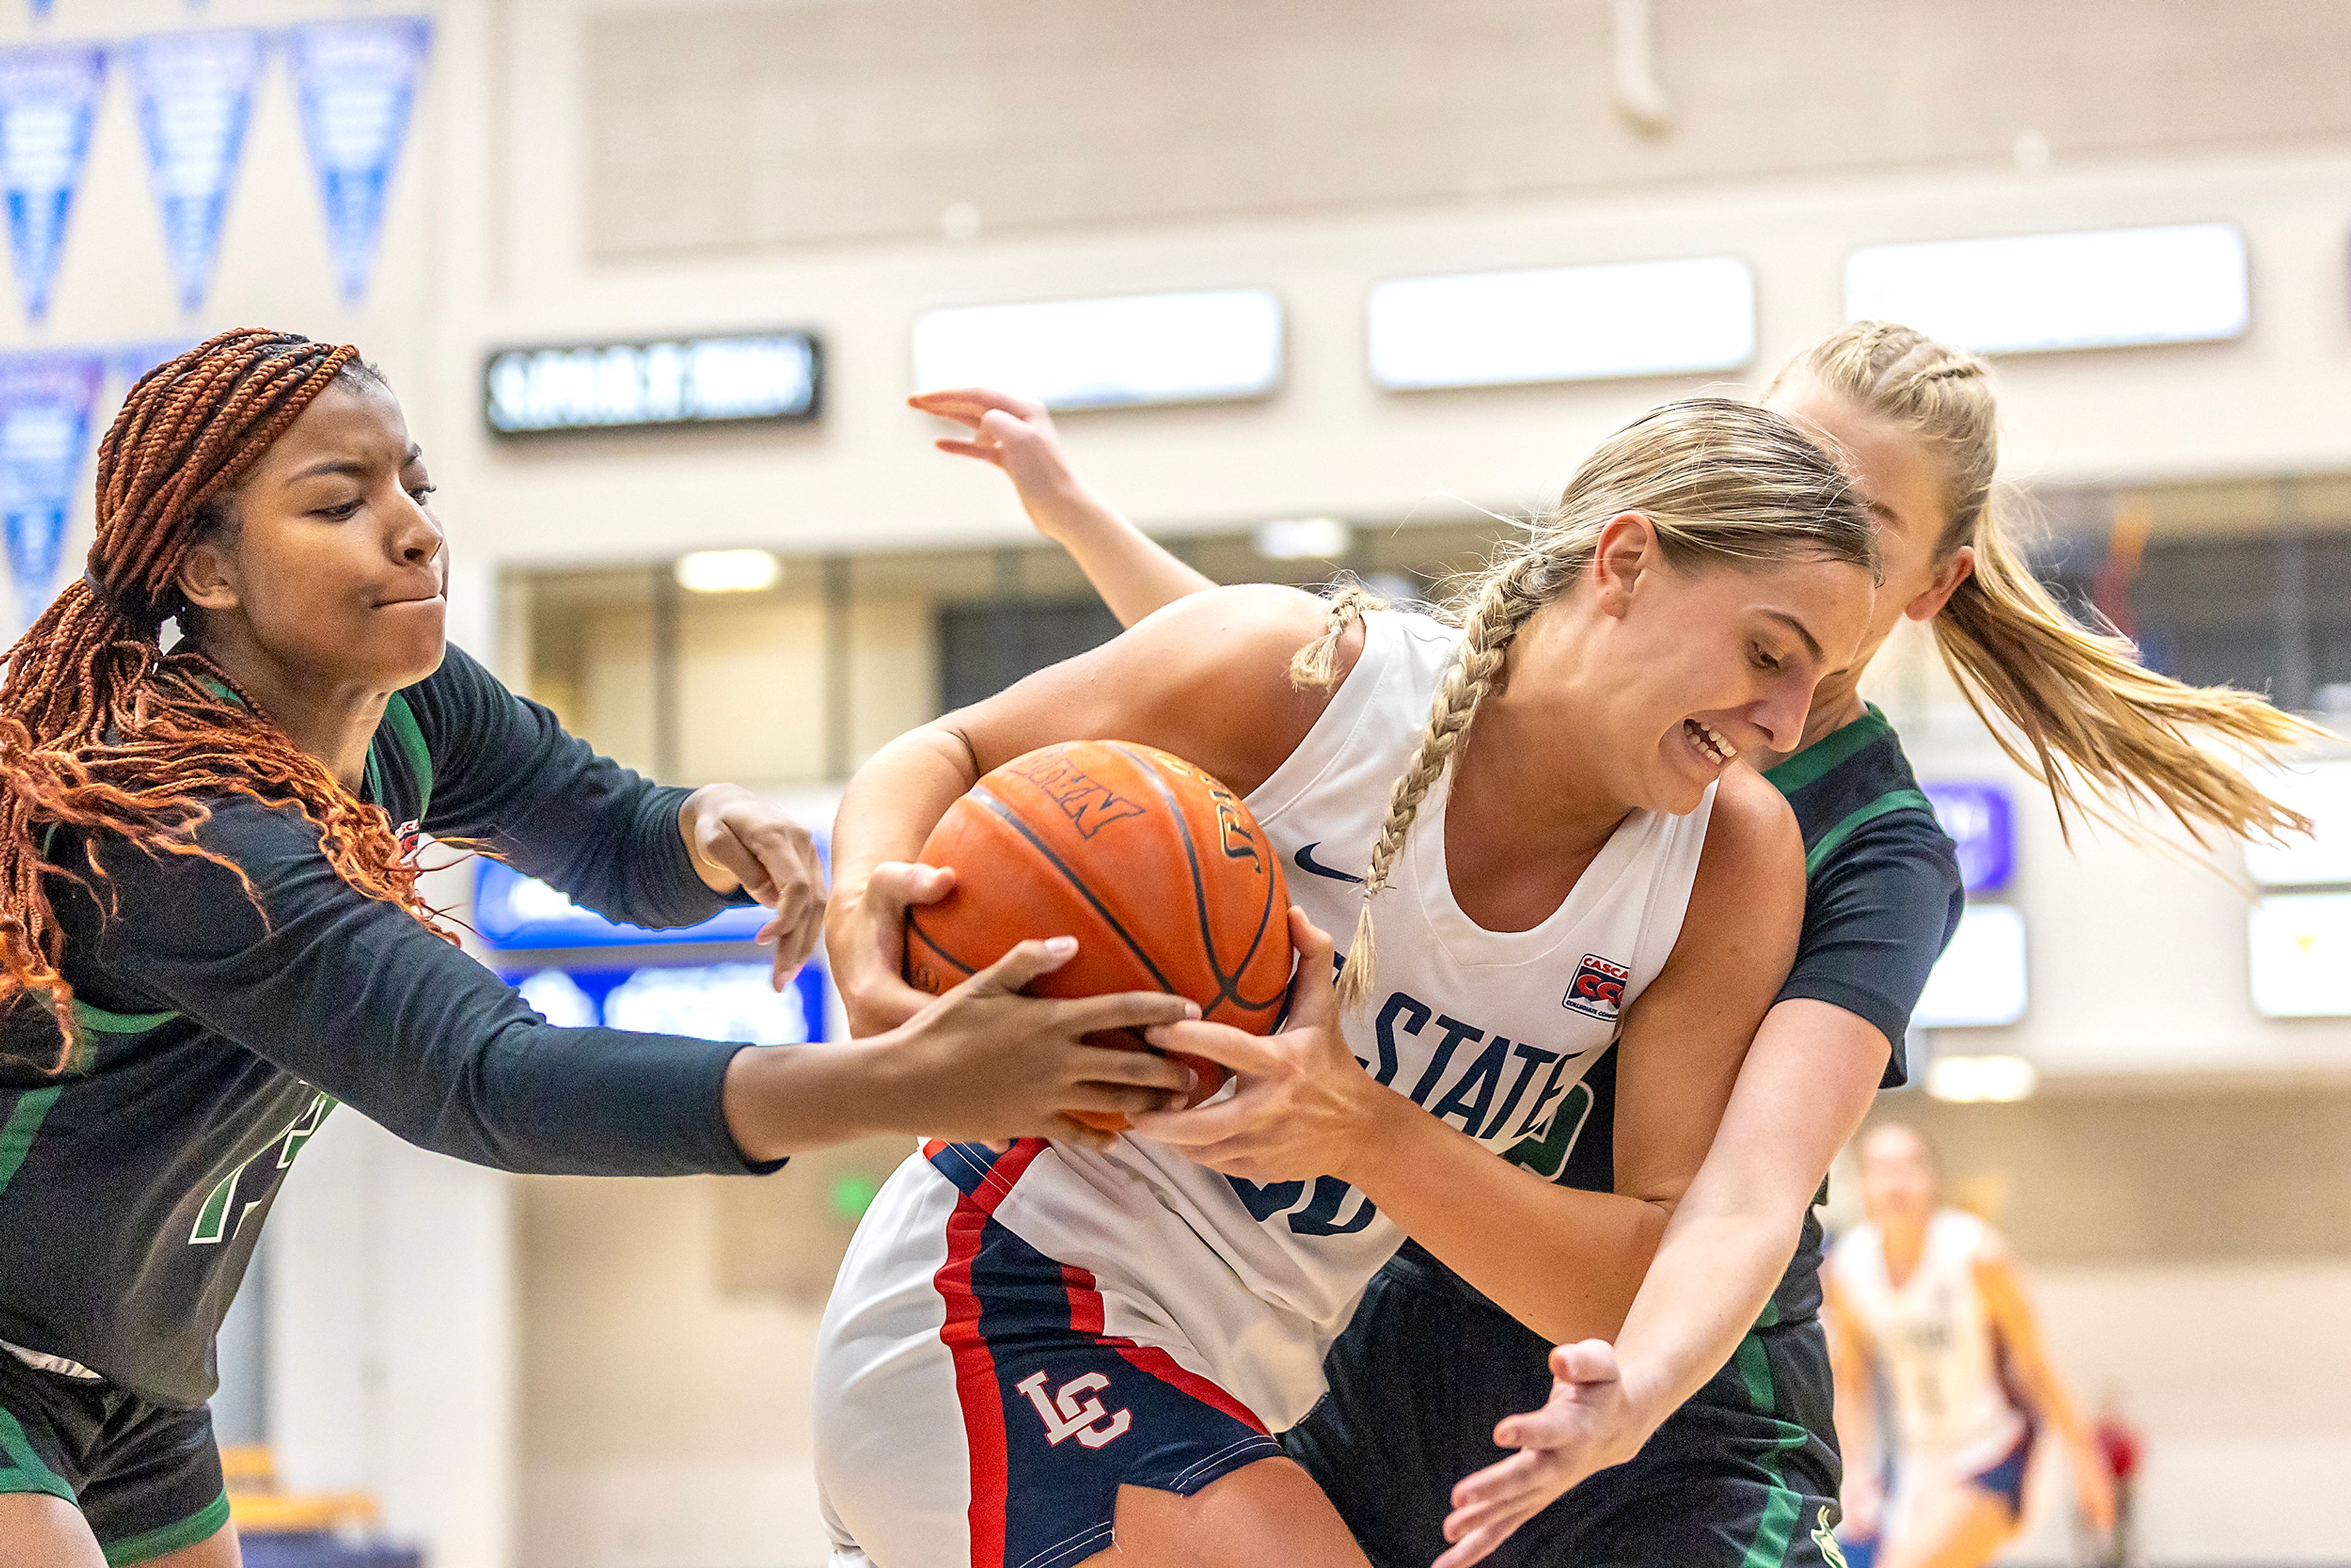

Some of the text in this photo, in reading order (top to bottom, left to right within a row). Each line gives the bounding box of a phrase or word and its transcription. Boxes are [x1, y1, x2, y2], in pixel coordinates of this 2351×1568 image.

[1565, 999, 1598, 1014] COLLEGIATE
[1374, 991, 1588, 1140] STATE
[1014, 1369, 1133, 1450] LC
